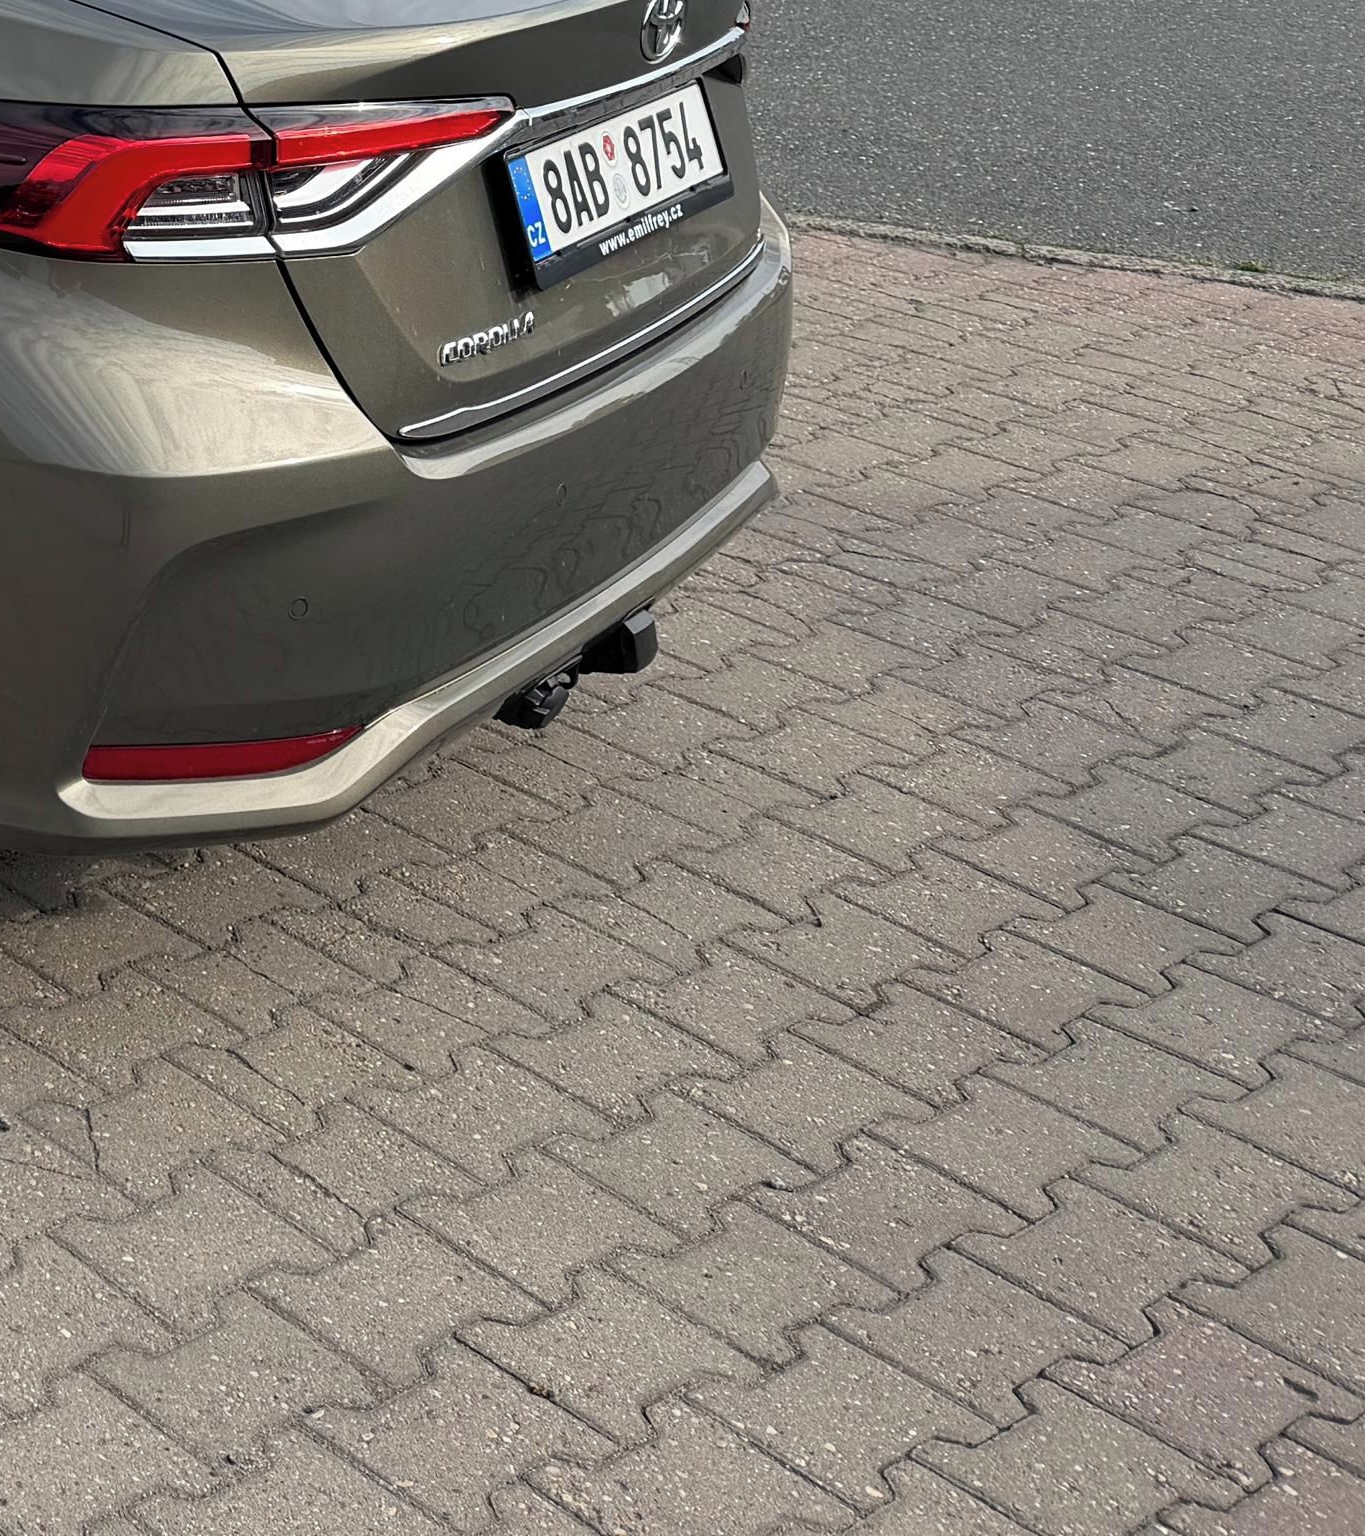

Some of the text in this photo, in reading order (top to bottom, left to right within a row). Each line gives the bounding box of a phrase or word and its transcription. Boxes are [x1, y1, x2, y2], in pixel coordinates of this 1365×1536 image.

[542, 101, 705, 234] 8AB 8754
[526, 221, 547, 248] CZ
[598, 202, 684, 256] www.emilfrey.cz
